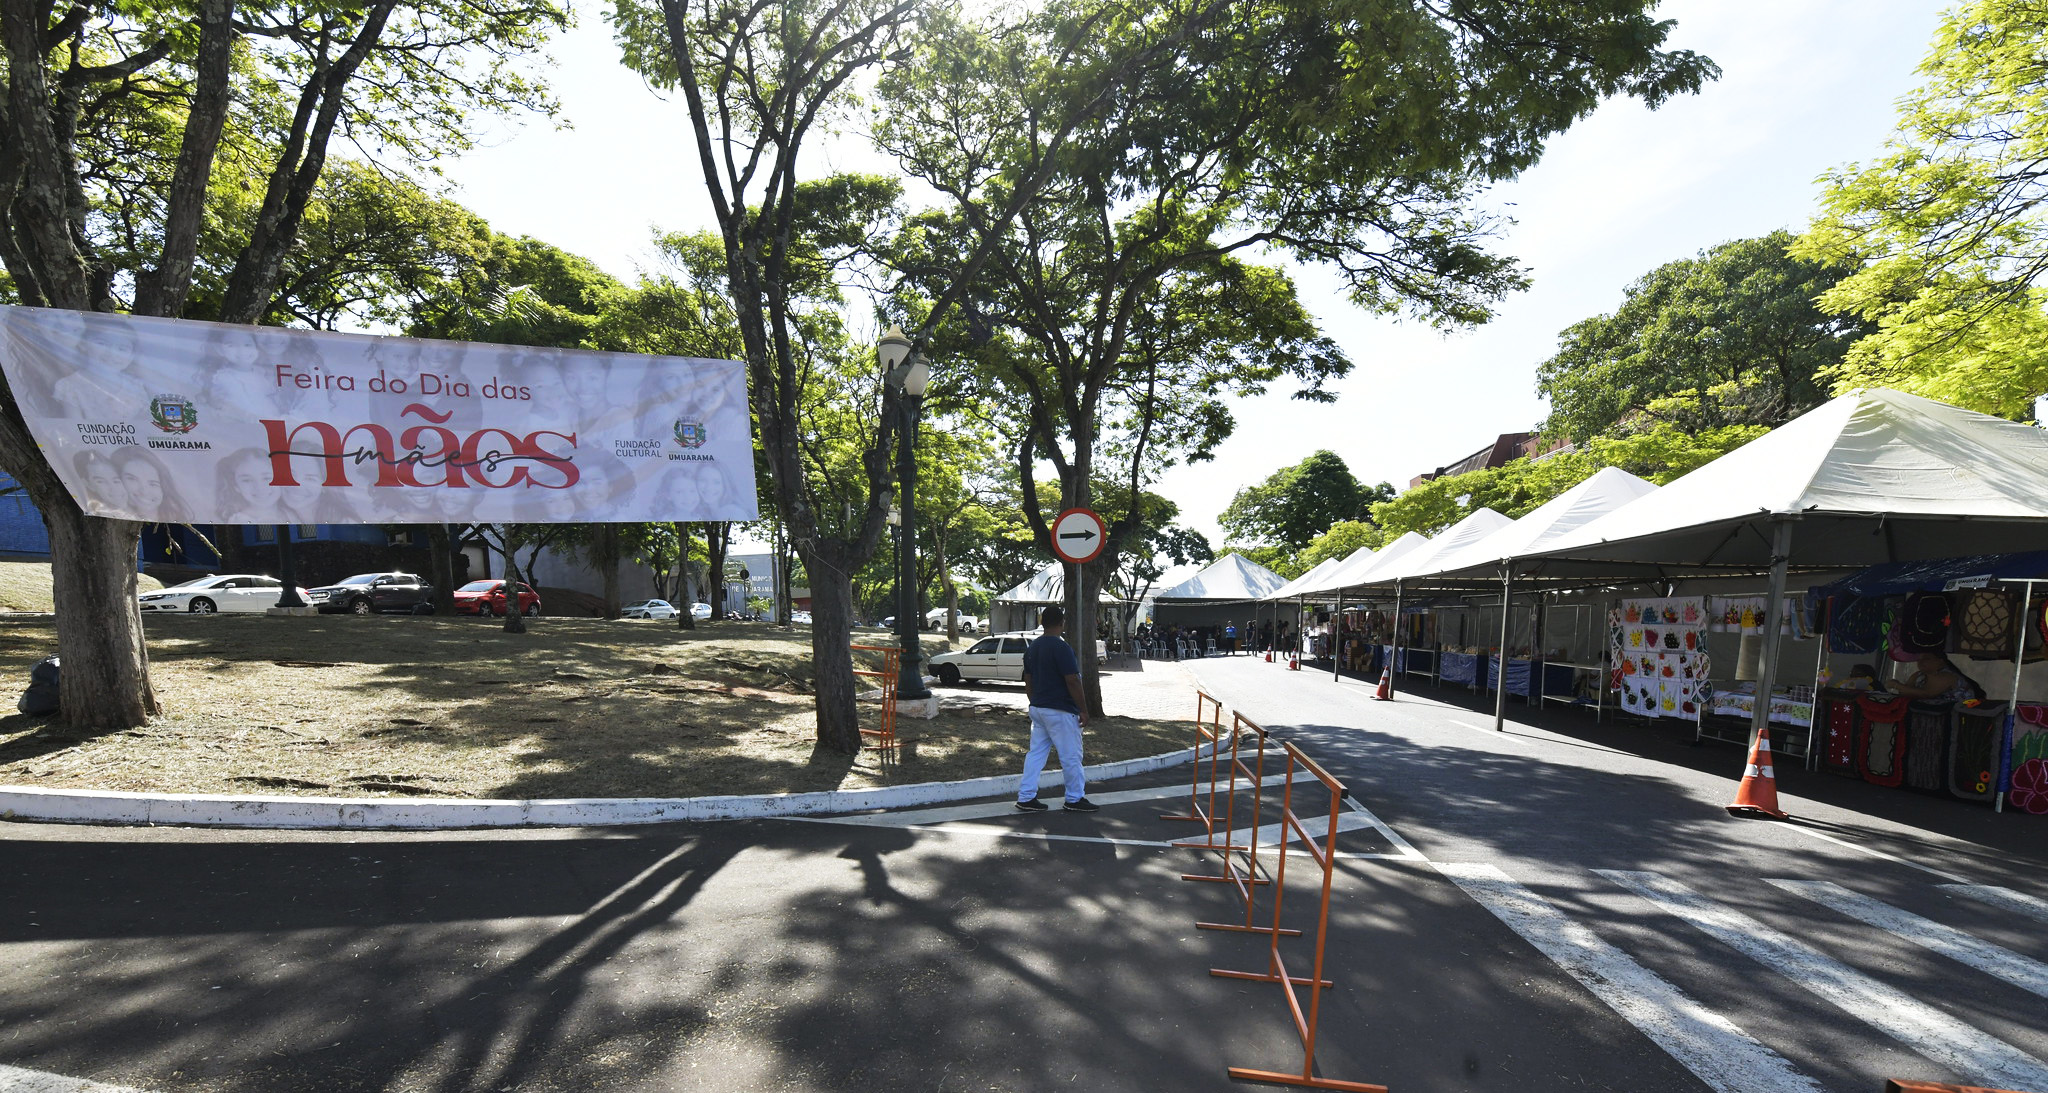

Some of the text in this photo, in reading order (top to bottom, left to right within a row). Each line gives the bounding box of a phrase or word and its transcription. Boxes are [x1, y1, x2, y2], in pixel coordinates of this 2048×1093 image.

[276, 364, 532, 401] Feira do Dia das
[77, 421, 136, 435] FUNDAÇÃO
[81, 435, 140, 446] CULTURAL
[148, 440, 212, 450] UMUARAMA
[259, 403, 580, 489] mães
[615, 439, 661, 449] FUNDAÇÃO
[616, 449, 662, 457] CULTURAL
